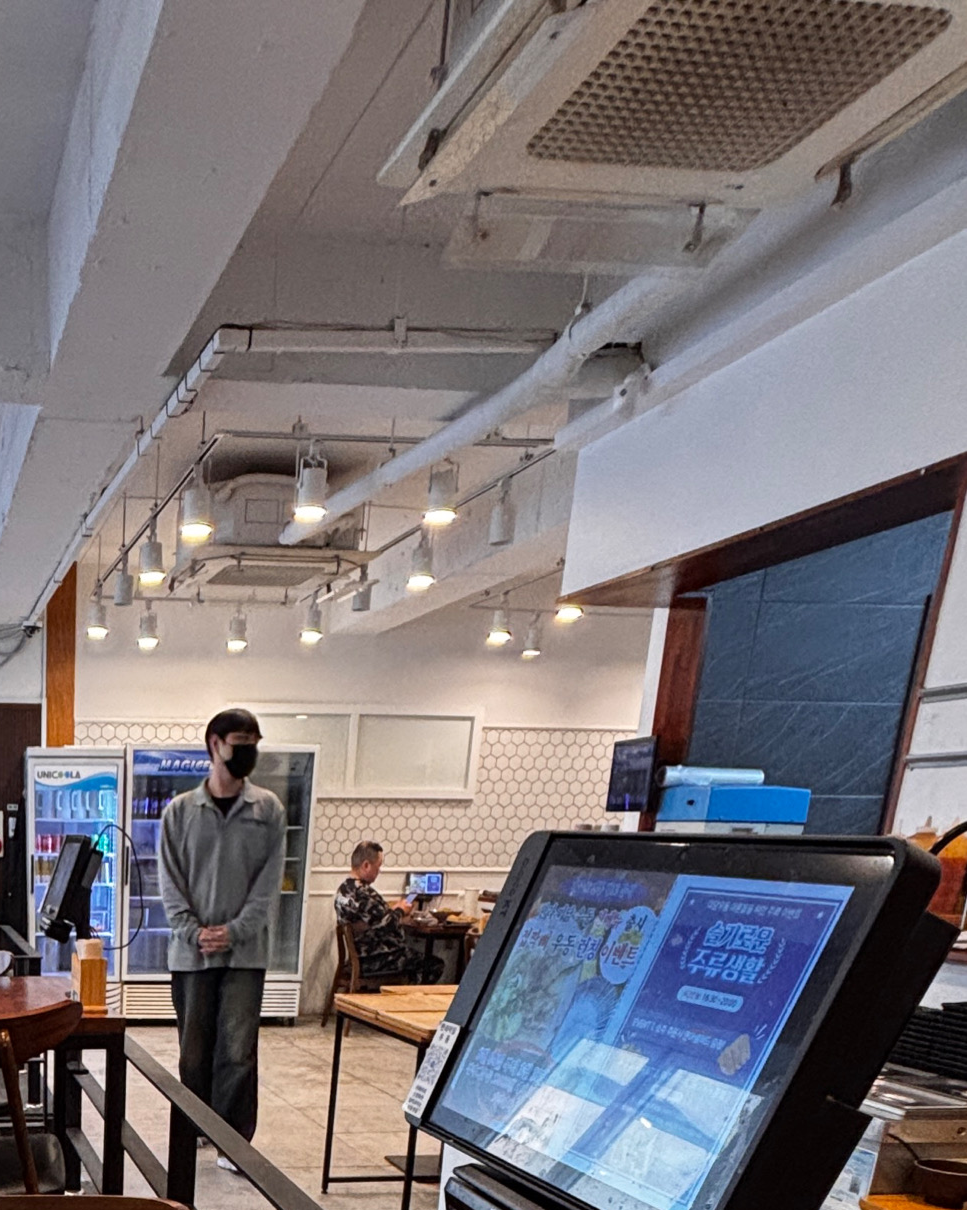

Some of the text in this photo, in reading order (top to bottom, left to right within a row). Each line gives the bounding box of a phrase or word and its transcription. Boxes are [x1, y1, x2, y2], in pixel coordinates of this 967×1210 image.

[552, 934, 576, 956] 우동
[600, 941, 640, 969] 이벤트
[703, 920, 775, 954] 슬기로운
[687, 948, 766, 984] 주류생활
